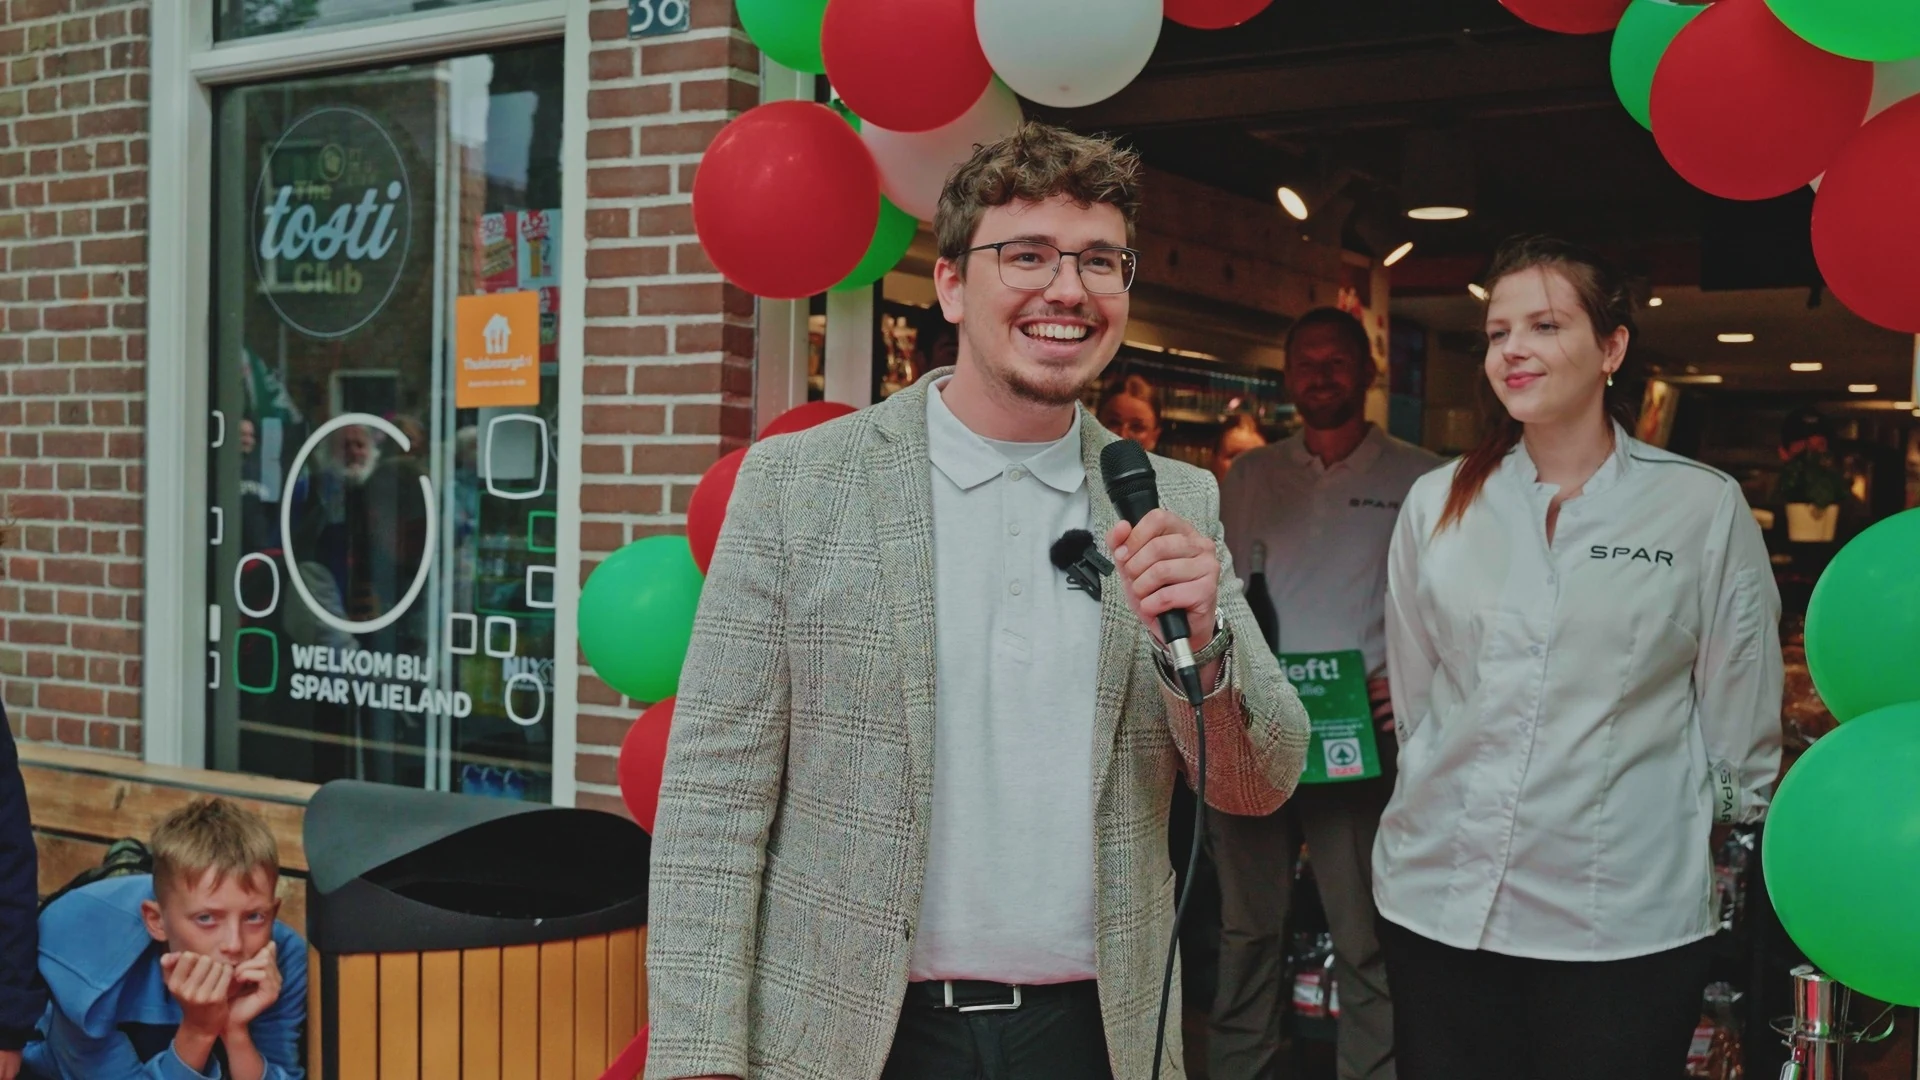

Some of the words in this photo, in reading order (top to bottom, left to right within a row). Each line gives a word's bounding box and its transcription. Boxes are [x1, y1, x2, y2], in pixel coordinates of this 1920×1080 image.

[260, 181, 402, 260] tosti
[294, 263, 363, 294] Club
[1349, 498, 1399, 510] SPAR
[1590, 545, 1674, 567] SPAR
[291, 643, 393, 678] WELKOM
[396, 654, 433, 683] BIJ
[290, 673, 350, 704] SPAR
[351, 680, 472, 718] VLIELAND
